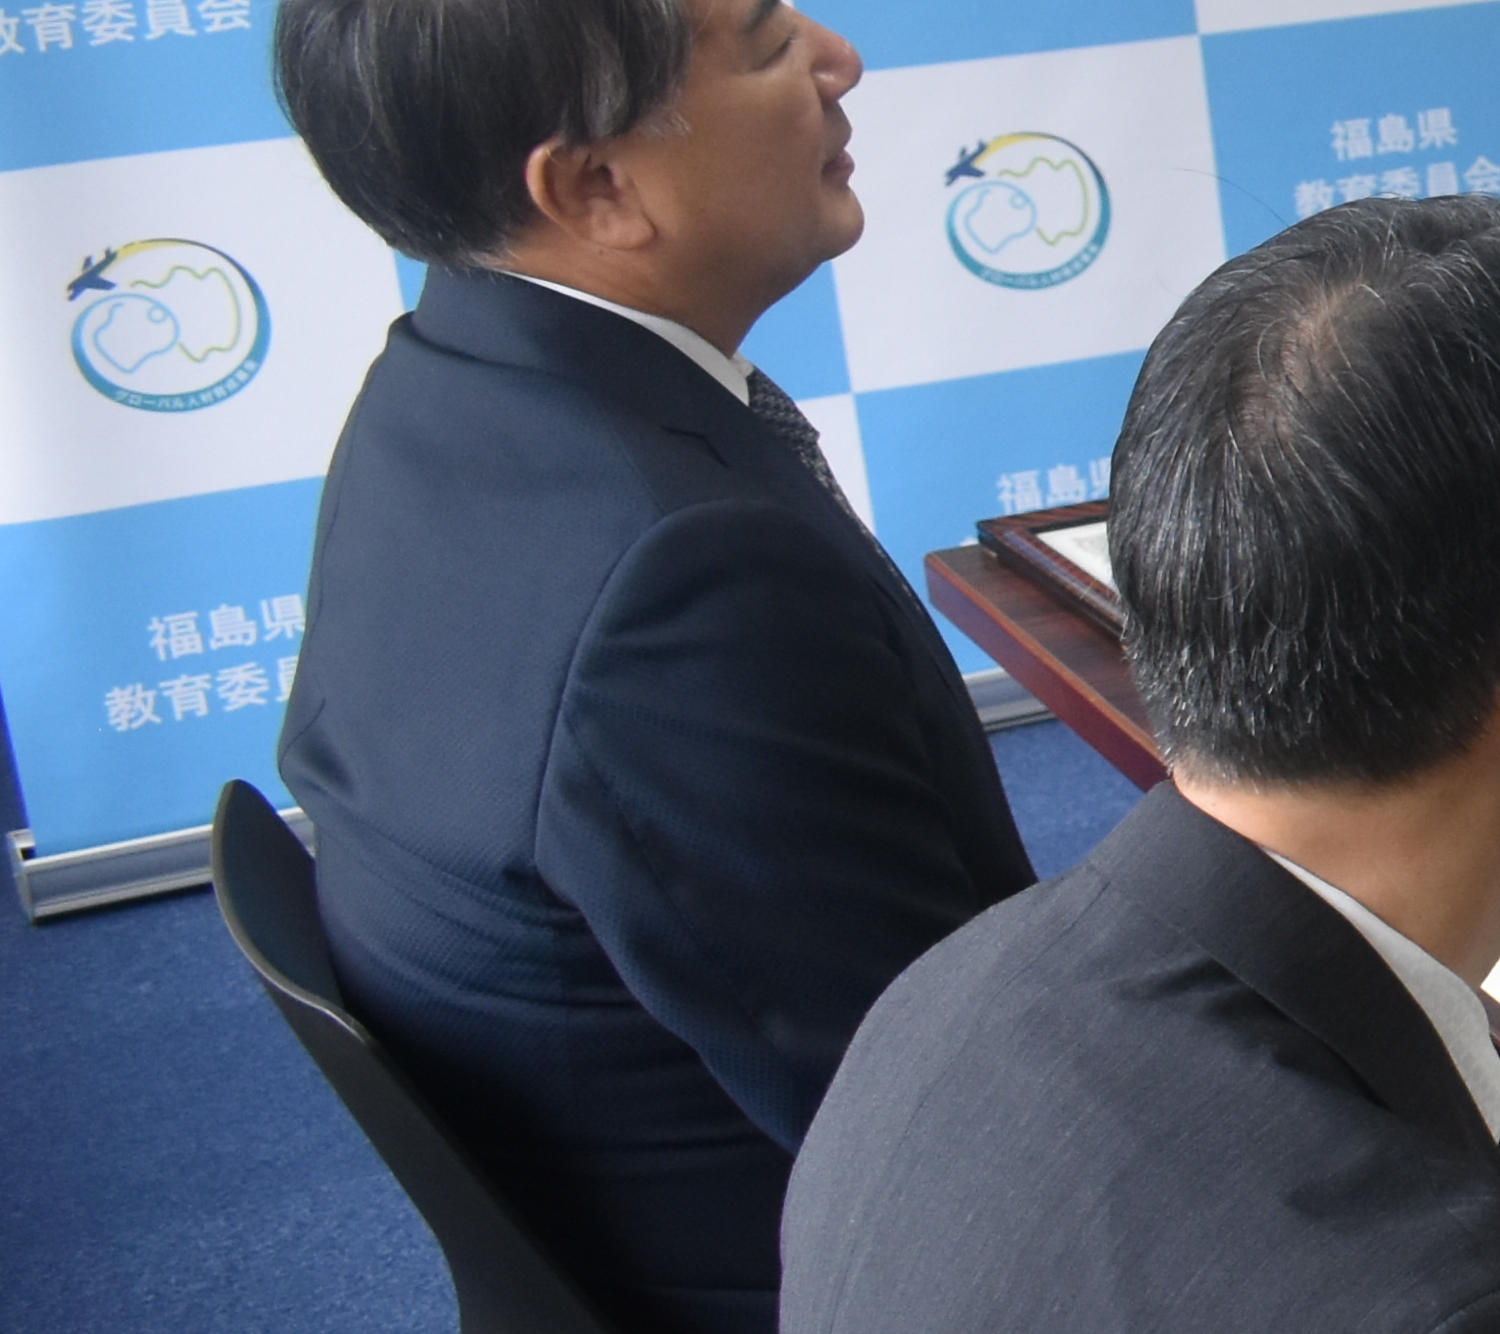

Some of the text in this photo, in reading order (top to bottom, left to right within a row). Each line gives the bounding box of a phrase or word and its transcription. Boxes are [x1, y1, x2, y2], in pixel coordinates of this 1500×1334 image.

[1330, 107, 1457, 161] 福島県
[148, 593, 306, 661] 福島県
